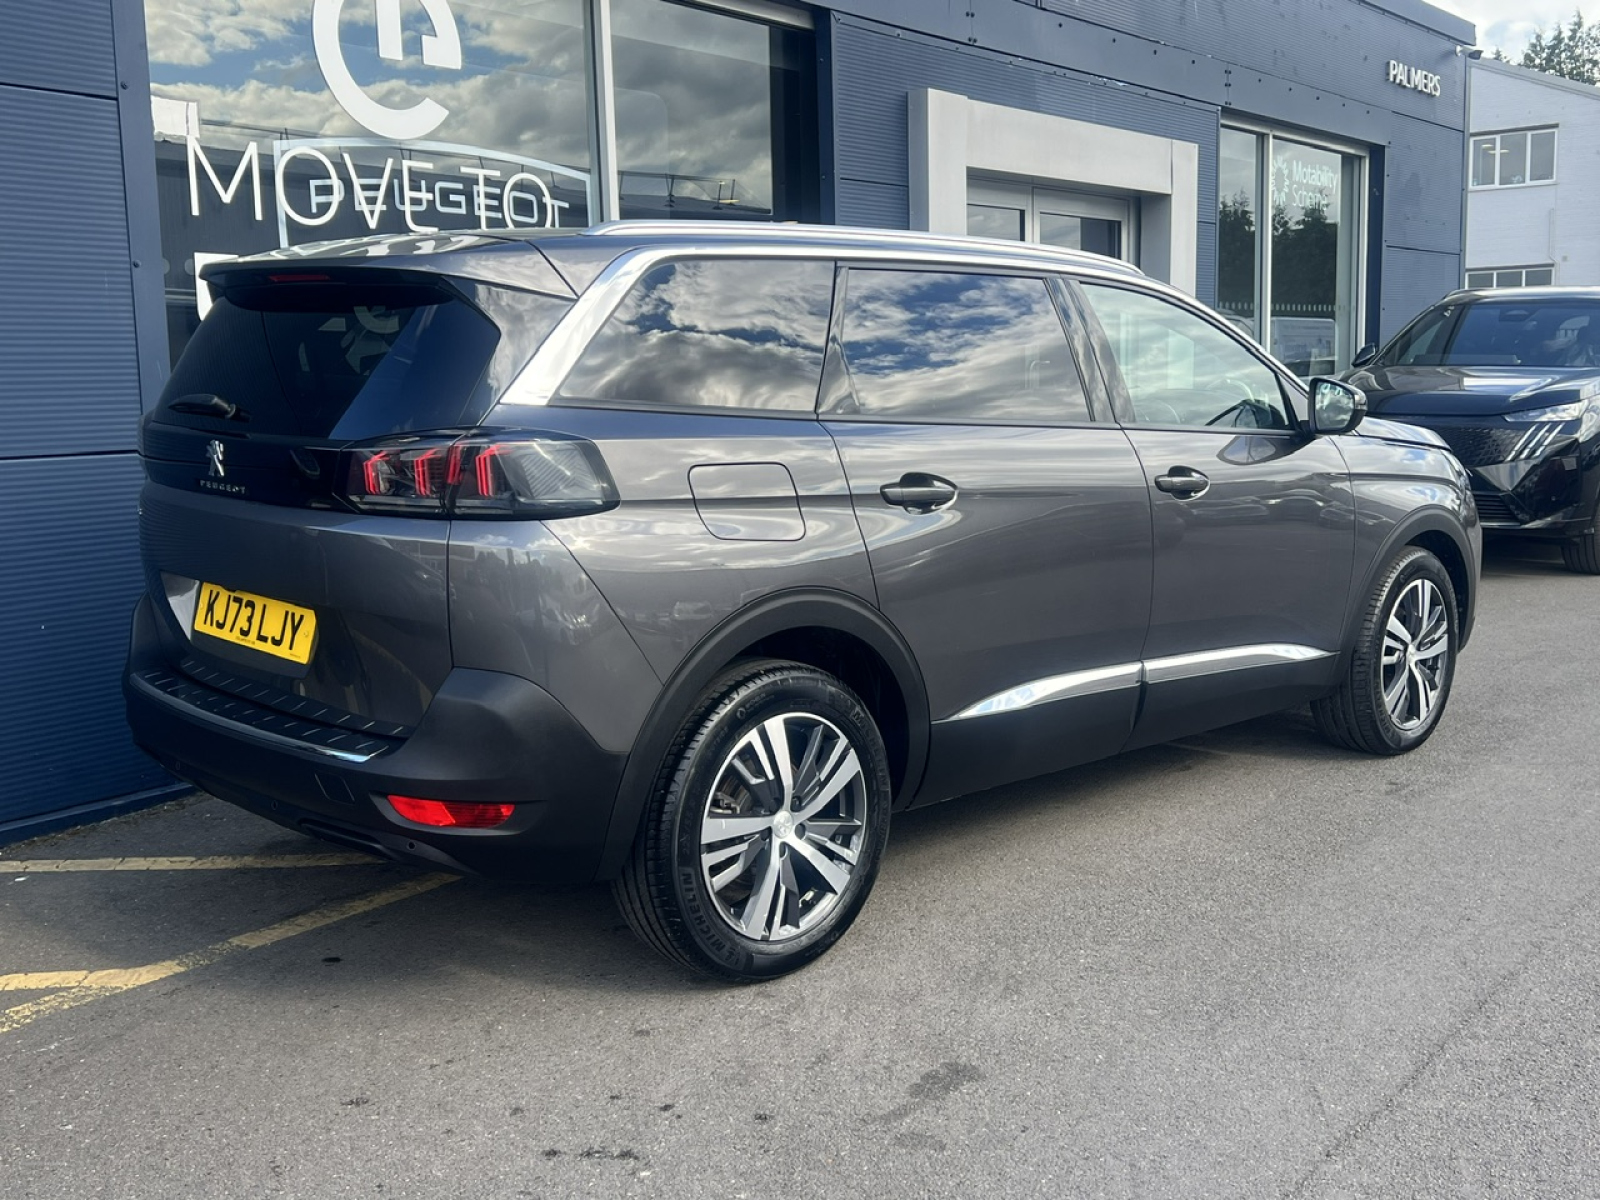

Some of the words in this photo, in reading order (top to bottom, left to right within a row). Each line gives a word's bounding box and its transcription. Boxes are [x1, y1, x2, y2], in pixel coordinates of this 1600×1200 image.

[1388, 60, 1441, 96] PALMERS
[186, 134, 439, 233] MOVE
[460, 166, 553, 229] TO
[1293, 160, 1338, 194] Motability
[309, 178, 569, 228] PEUGEOT
[200, 480, 245, 494] PEUGEOT
[204, 590, 255, 636] KJ73
[256, 603, 304, 650] LJY
[681, 872, 726, 952] MICHELIN
